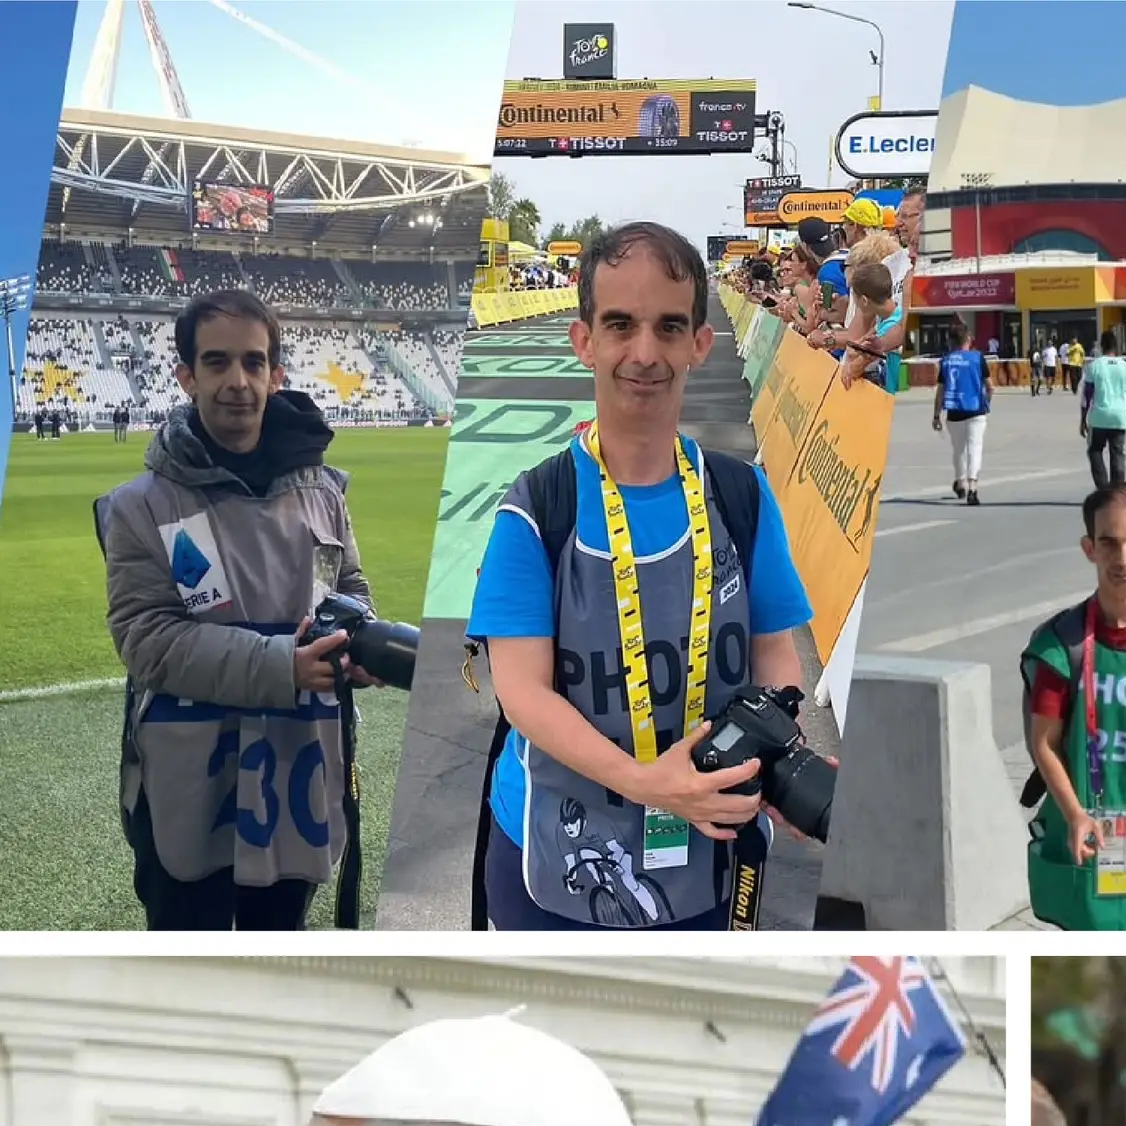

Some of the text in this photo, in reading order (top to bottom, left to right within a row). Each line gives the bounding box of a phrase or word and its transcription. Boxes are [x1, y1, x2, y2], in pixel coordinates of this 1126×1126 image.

[499, 101, 605, 127] Continental
[569, 137, 627, 149] TISSOT
[696, 130, 748, 142] TISSOT
[762, 176, 799, 187] TISSOT
[782, 200, 842, 215] Continental
[798, 419, 871, 537] Continental
[213, 587, 222, 601] A
[735, 864, 756, 919] Nikon
